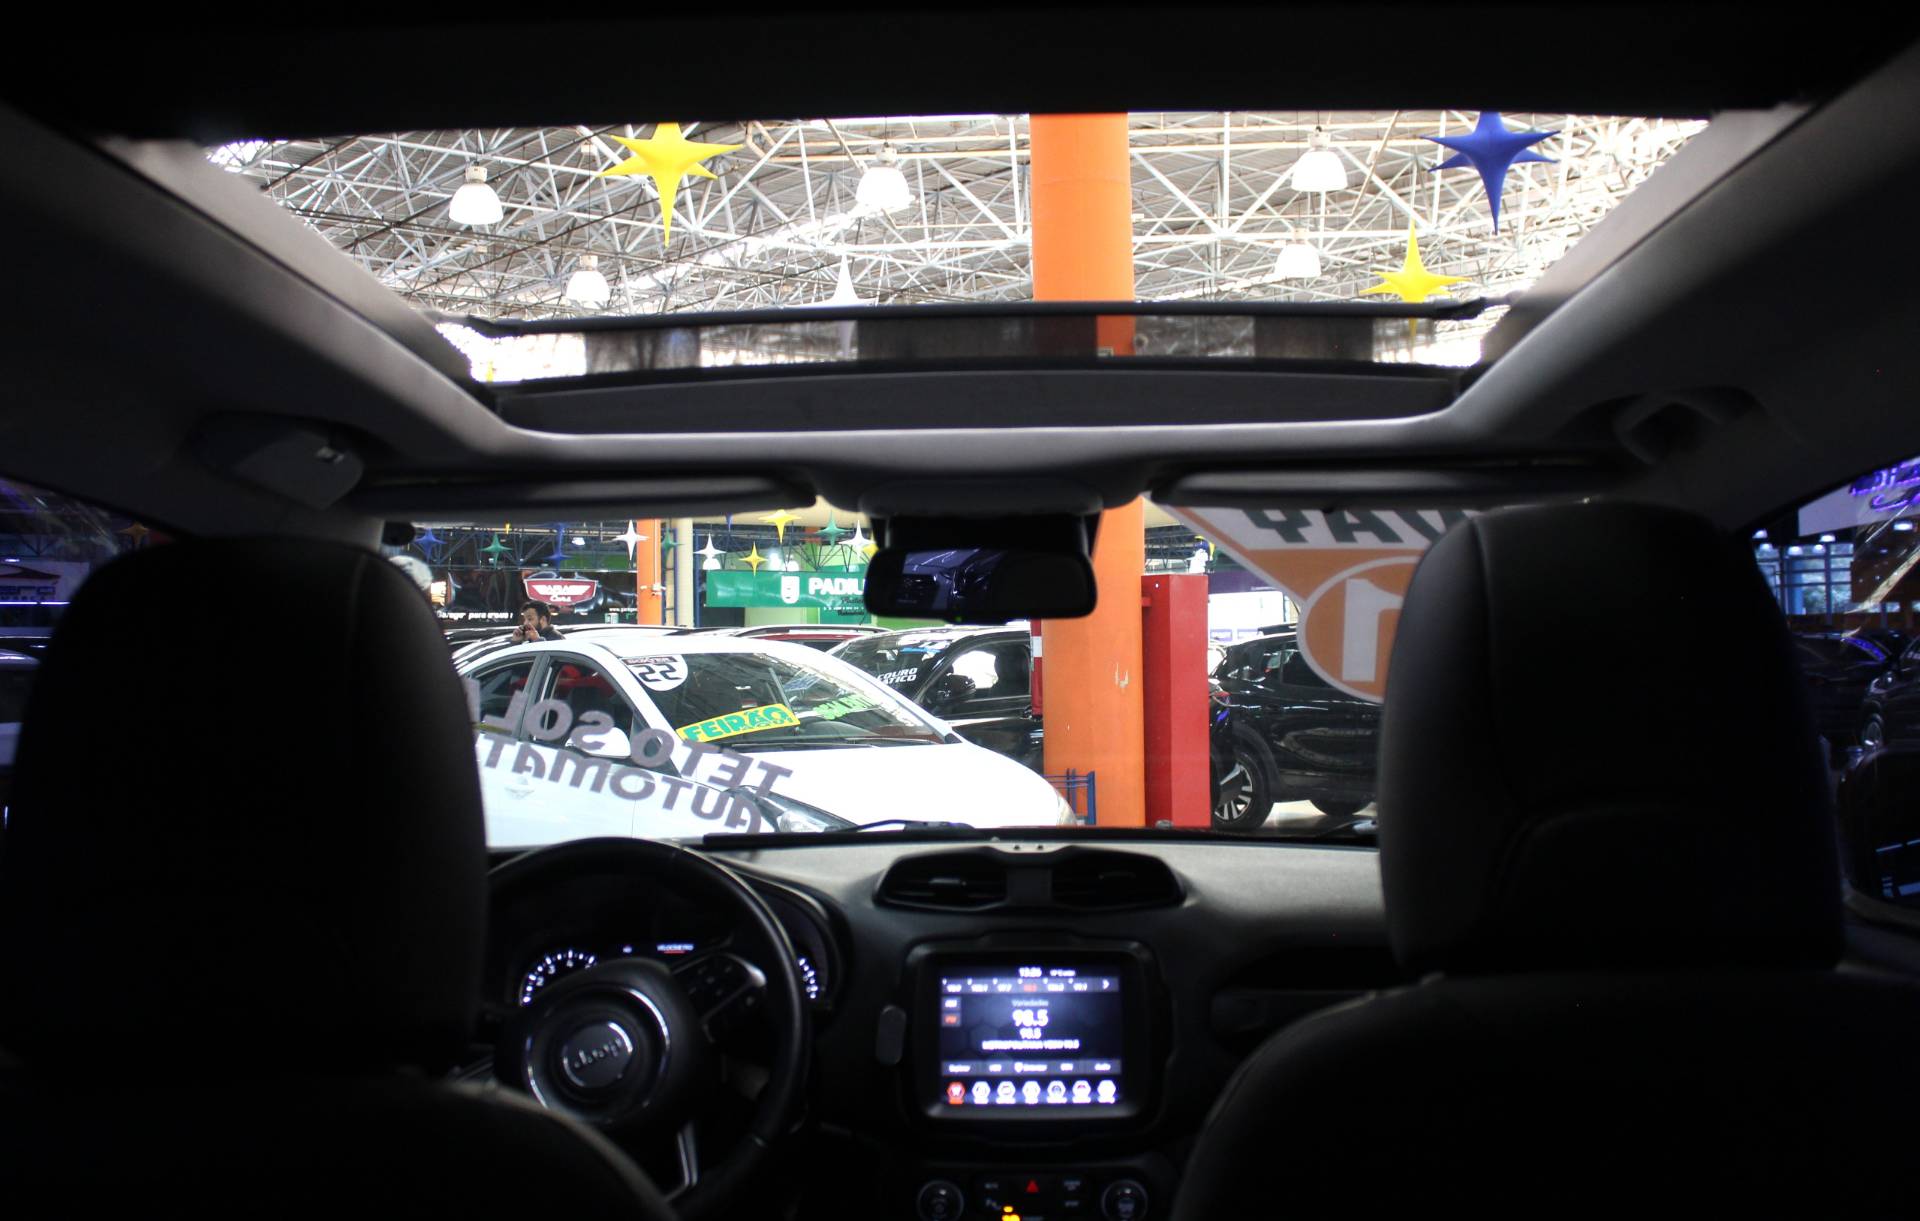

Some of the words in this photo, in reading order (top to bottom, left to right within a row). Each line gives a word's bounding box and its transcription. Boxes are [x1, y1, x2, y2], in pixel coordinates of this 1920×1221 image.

[808, 577, 864, 596] PADIL
[632, 663, 684, 683] 22
[682, 705, 789, 742] FEIRÃO
[1011, 1009, 1049, 1027] 98.5
